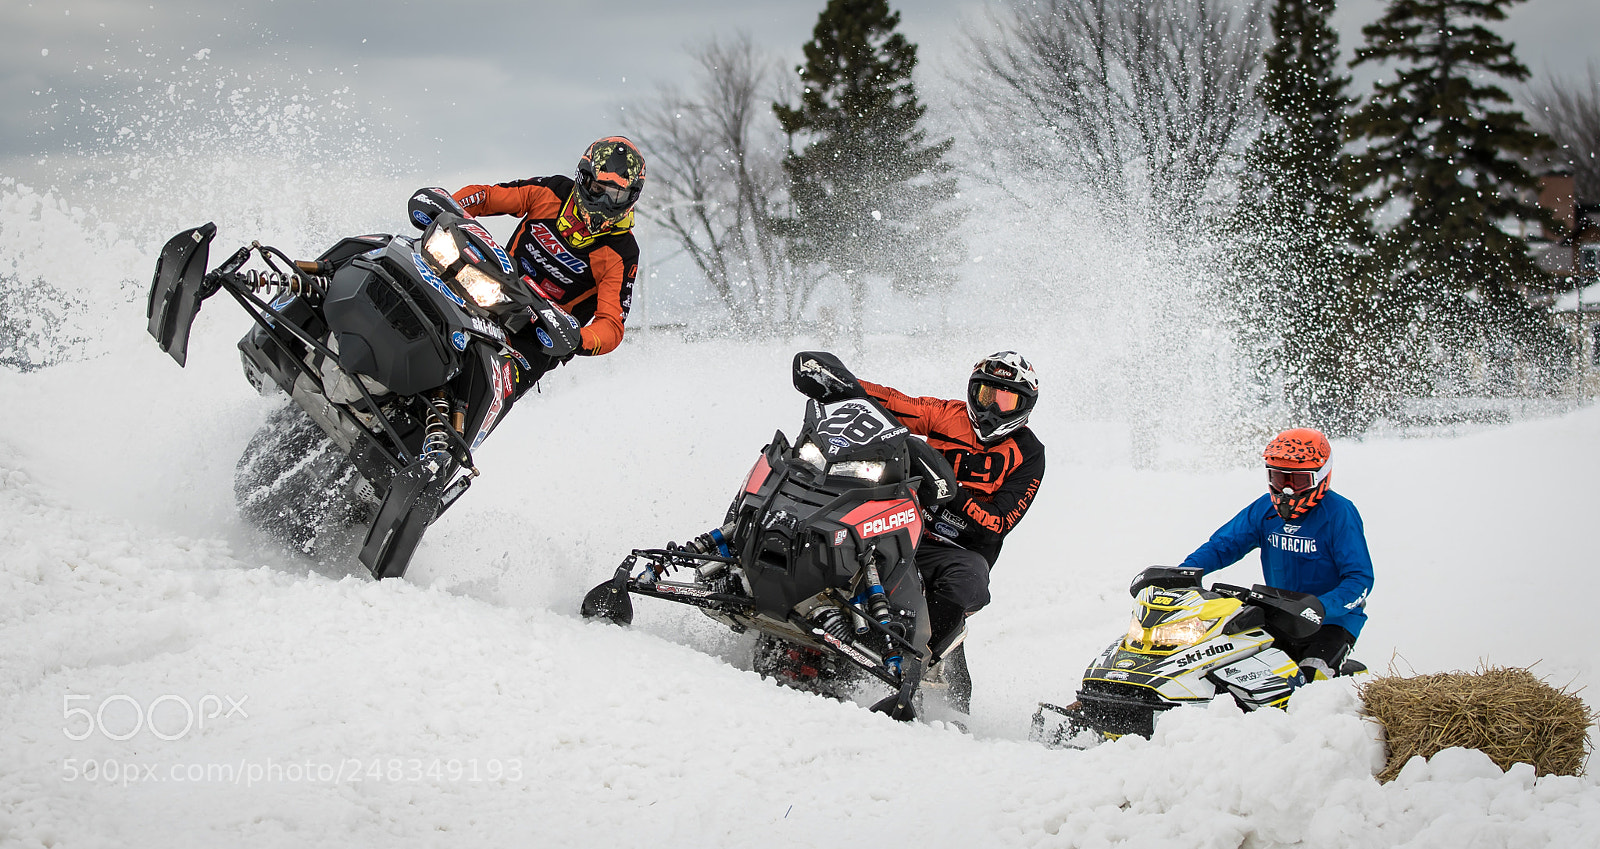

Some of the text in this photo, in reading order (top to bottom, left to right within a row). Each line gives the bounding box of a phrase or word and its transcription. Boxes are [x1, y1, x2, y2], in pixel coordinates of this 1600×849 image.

[530, 223, 588, 274] AMSOIL
[525, 243, 573, 284] ski-doo
[817, 407, 884, 445] 28
[881, 427, 908, 441] POLARIS
[863, 508, 916, 537] POLARIS
[1281, 538, 1317, 554] RACING
[1176, 642, 1234, 668] ski-doo
